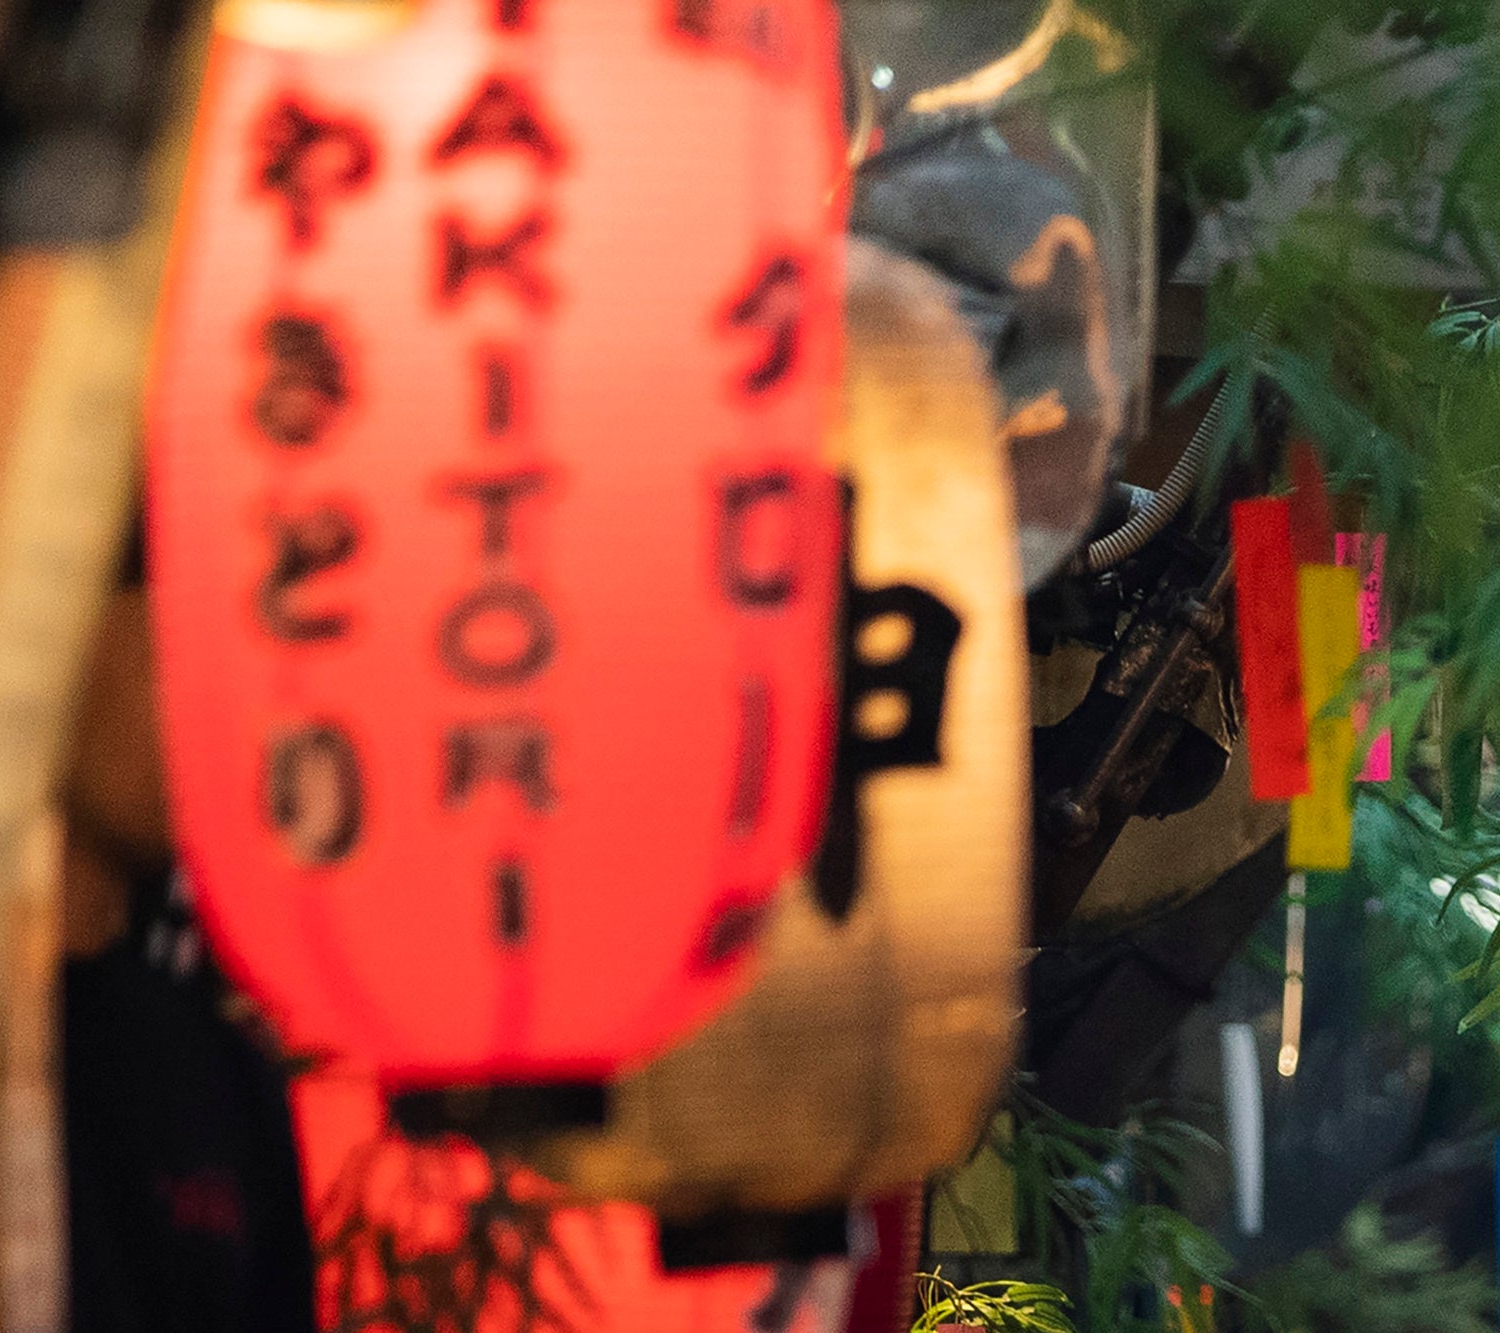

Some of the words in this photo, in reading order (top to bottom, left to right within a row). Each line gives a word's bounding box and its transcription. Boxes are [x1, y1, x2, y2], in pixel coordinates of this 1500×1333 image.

[252, 92, 380, 868] やきとり
[434, 0, 562, 945] AKITORI
